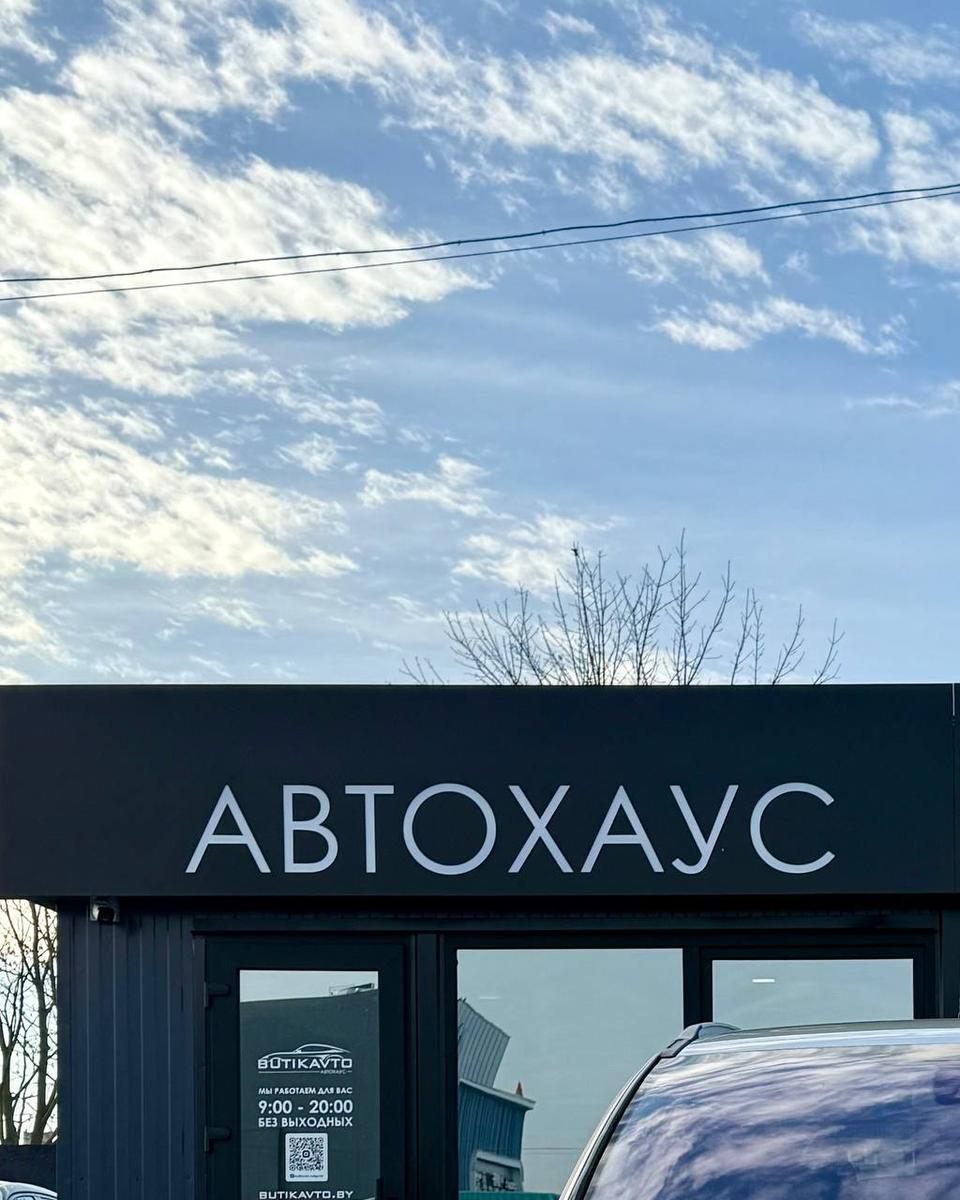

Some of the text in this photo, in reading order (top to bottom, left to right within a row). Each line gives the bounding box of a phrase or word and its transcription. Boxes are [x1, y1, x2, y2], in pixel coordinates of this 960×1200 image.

[185, 782, 836, 876] АВТОХАУС
[258, 1058, 353, 1069] BUTIKAVTO
[258, 1087, 273, 1095] МЫ
[274, 1087, 317, 1095] РАБОТАЕМ
[317, 1087, 335, 1095] ДЛЯ
[258, 1100, 293, 1114] 9:00
[309, 1100, 353, 1114] 20:00
[258, 1116, 353, 1128] БЕЗ ВЫХОДНЫХ
[259, 1190, 354, 1200] BUTIKAVTO.BY
